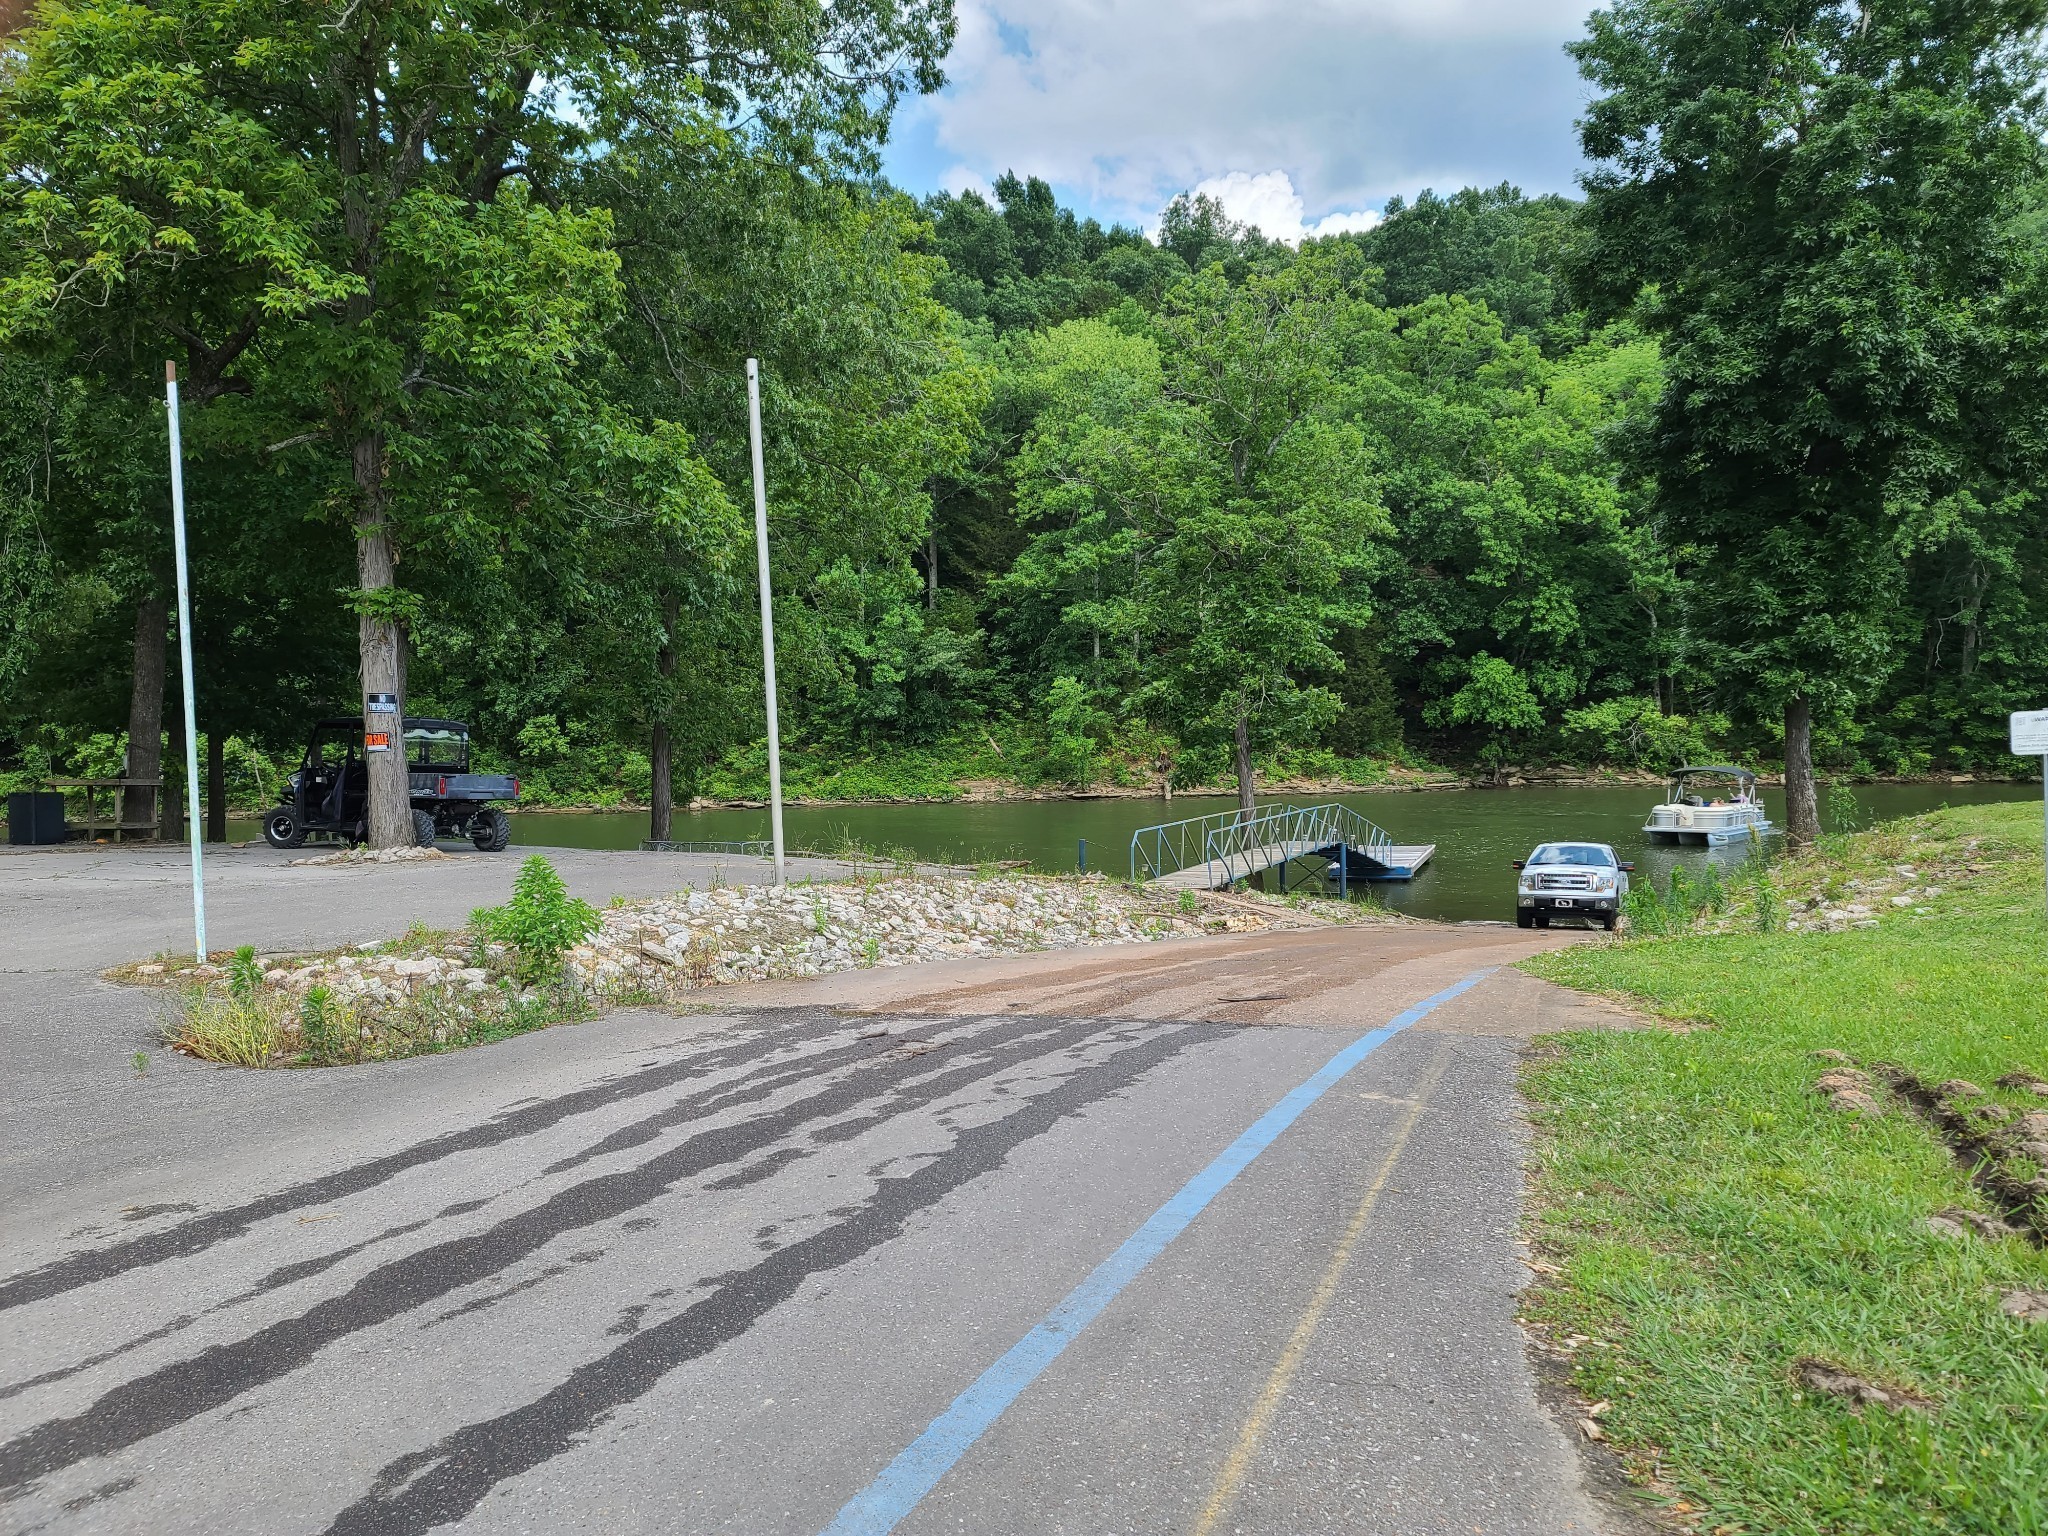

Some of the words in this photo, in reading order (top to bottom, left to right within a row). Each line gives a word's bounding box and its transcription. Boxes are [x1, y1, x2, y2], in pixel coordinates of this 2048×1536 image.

[379, 695, 386, 703] NO
[368, 703, 396, 711] TRESPASSING
[373, 733, 389, 745] SALE
